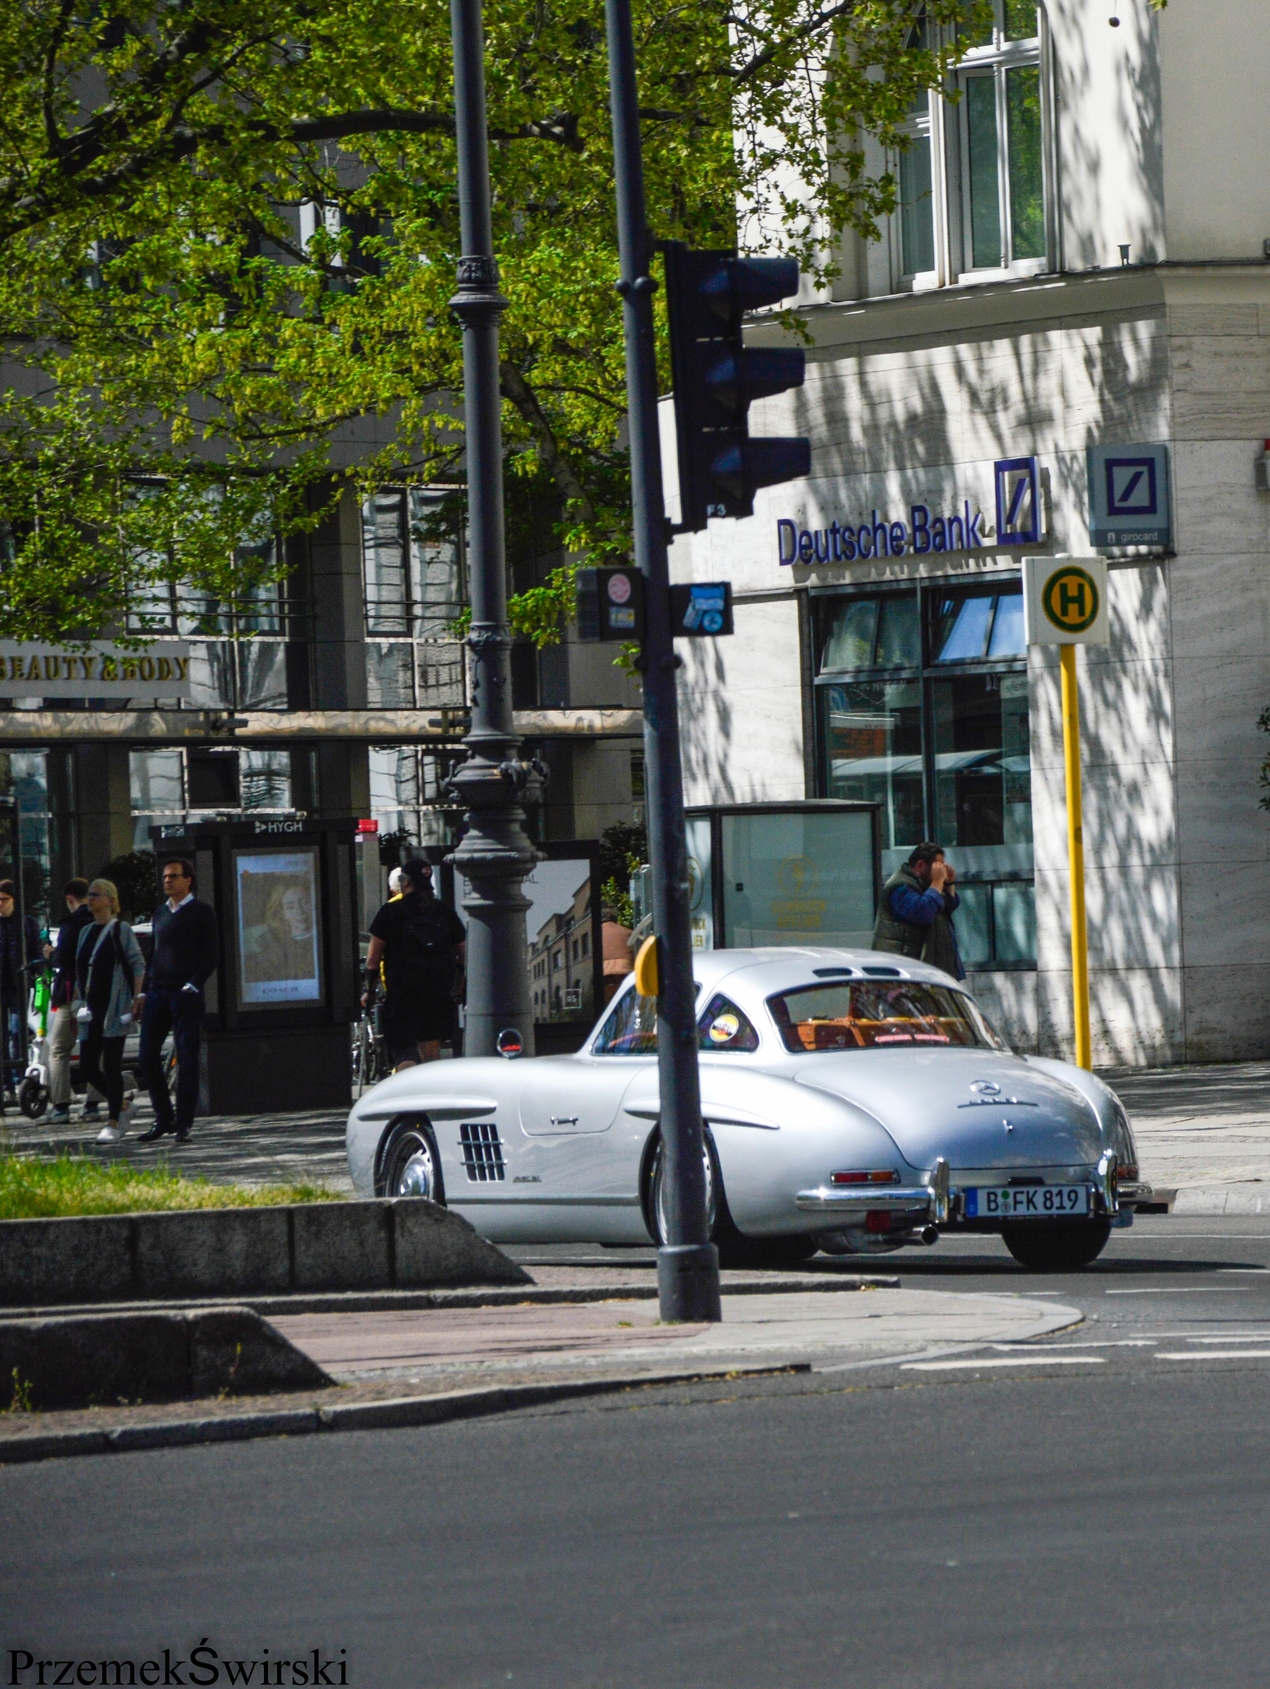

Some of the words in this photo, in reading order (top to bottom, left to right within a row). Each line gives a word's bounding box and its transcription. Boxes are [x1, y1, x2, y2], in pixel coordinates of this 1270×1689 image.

[777, 509, 908, 566] Deutsche
[911, 500, 984, 554] Bank
[1121, 531, 1158, 542] girocard
[1059, 583, 1086, 617] H
[268, 821, 302, 833] HYGH
[987, 1191, 999, 1212] B
[1013, 1190, 1038, 1212] FK
[1043, 1189, 1079, 1210] 819
